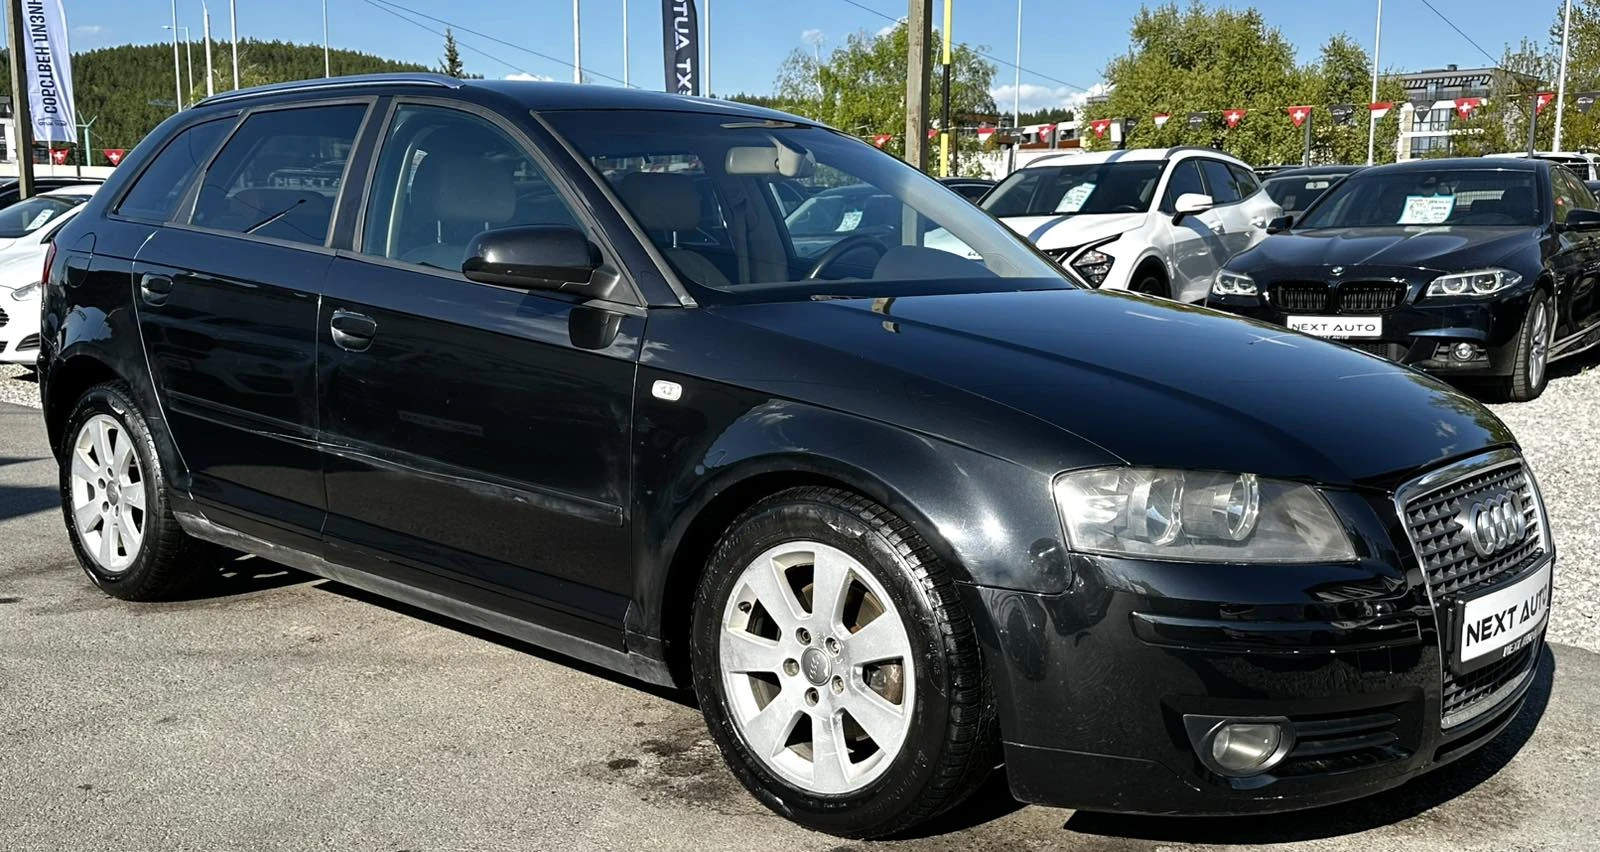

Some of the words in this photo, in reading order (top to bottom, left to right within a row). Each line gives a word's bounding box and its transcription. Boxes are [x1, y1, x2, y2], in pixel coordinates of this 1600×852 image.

[1291, 323, 1328, 331] NEXT
[1332, 323, 1376, 332] AUTO
[1466, 604, 1518, 647] NEXT
[1519, 583, 1548, 624] AUTO
